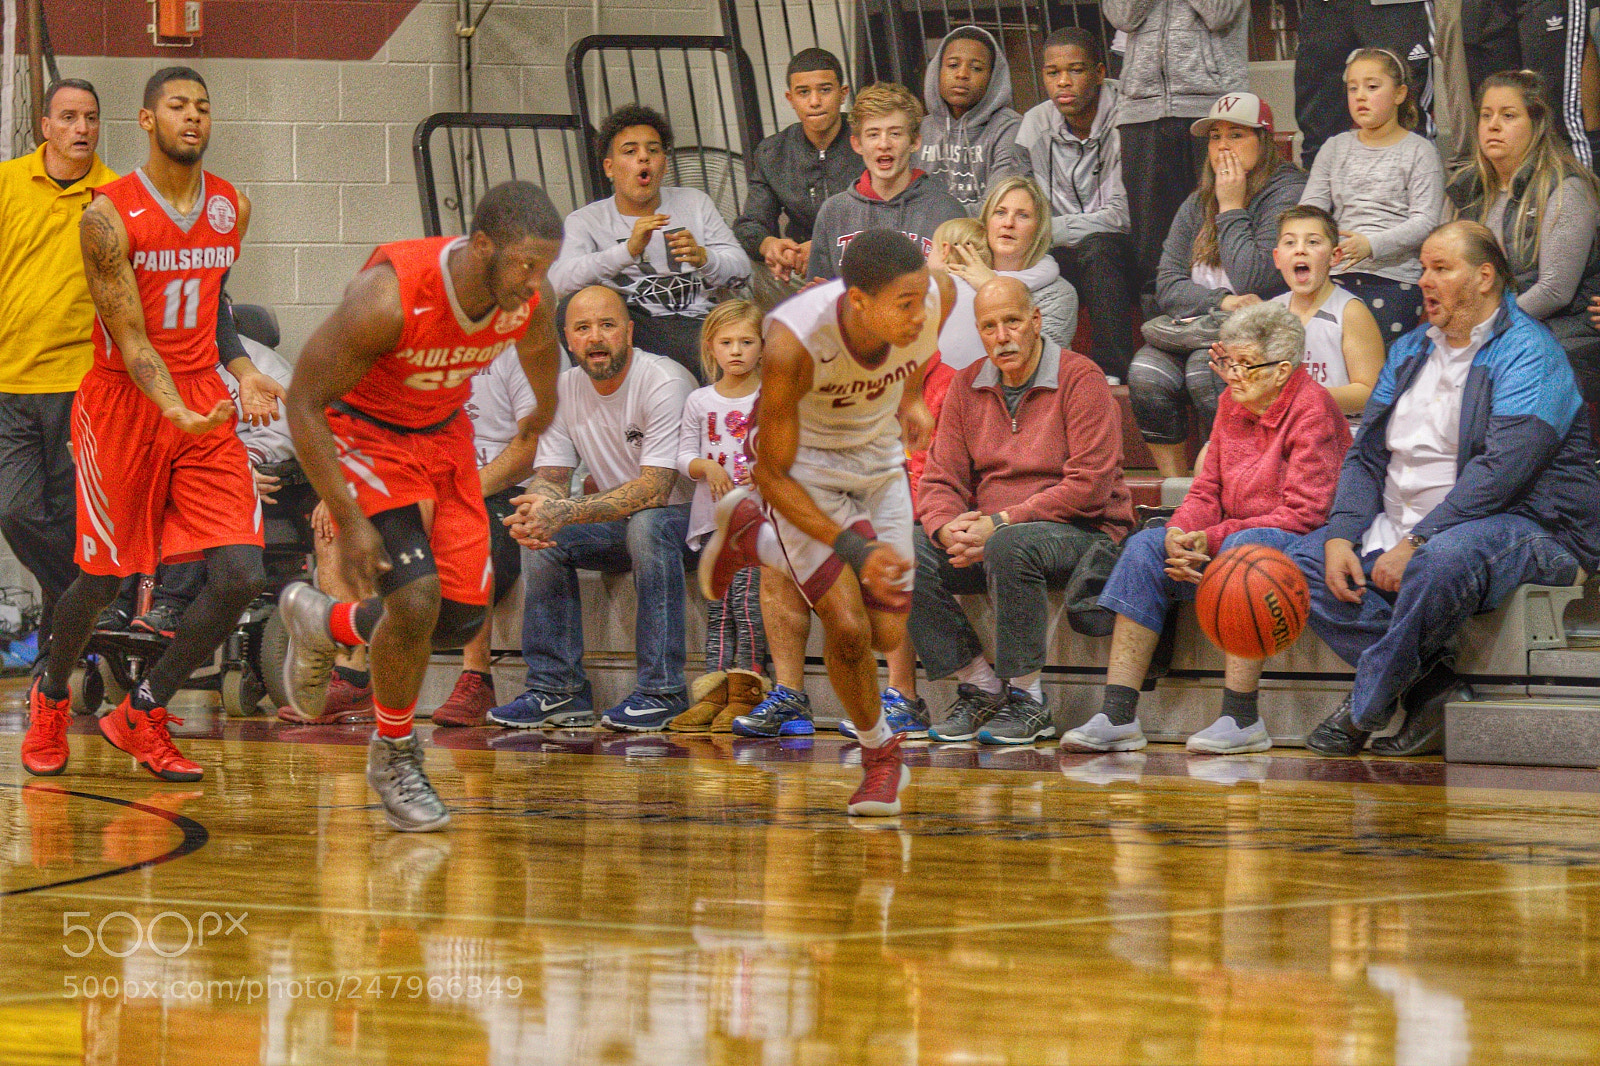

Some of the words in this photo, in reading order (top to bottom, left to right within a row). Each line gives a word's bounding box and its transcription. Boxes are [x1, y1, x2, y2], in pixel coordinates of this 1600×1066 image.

[1218, 96, 1241, 114] W
[920, 143, 984, 165] HOLLISTER
[133, 245, 236, 272] PAULSBORO
[162, 278, 202, 330] 11
[82, 533, 98, 563] P
